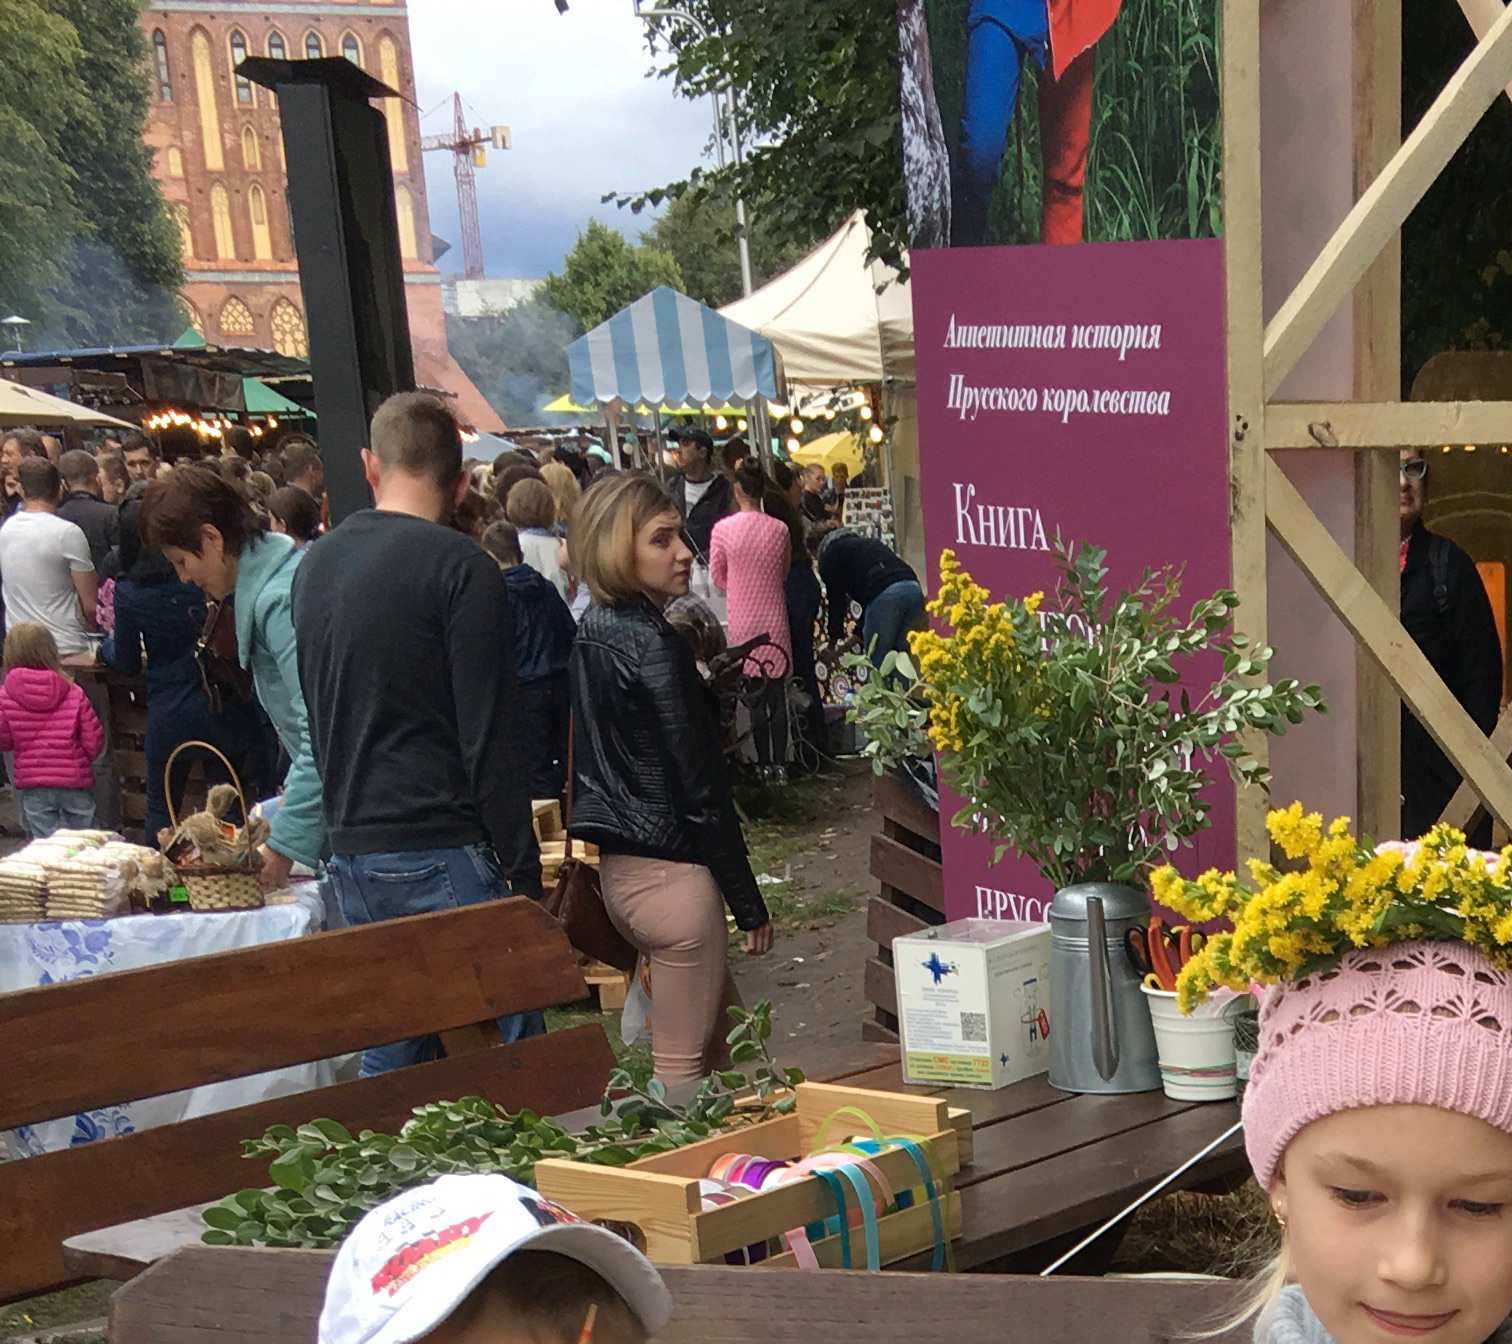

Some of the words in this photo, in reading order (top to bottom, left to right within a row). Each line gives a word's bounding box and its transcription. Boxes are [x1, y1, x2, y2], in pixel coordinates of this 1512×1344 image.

[943, 313, 1066, 348] Аппетитная
[1071, 324, 1162, 361] история
[947, 374, 1038, 420] Прусского
[1042, 389, 1171, 424] королевства
